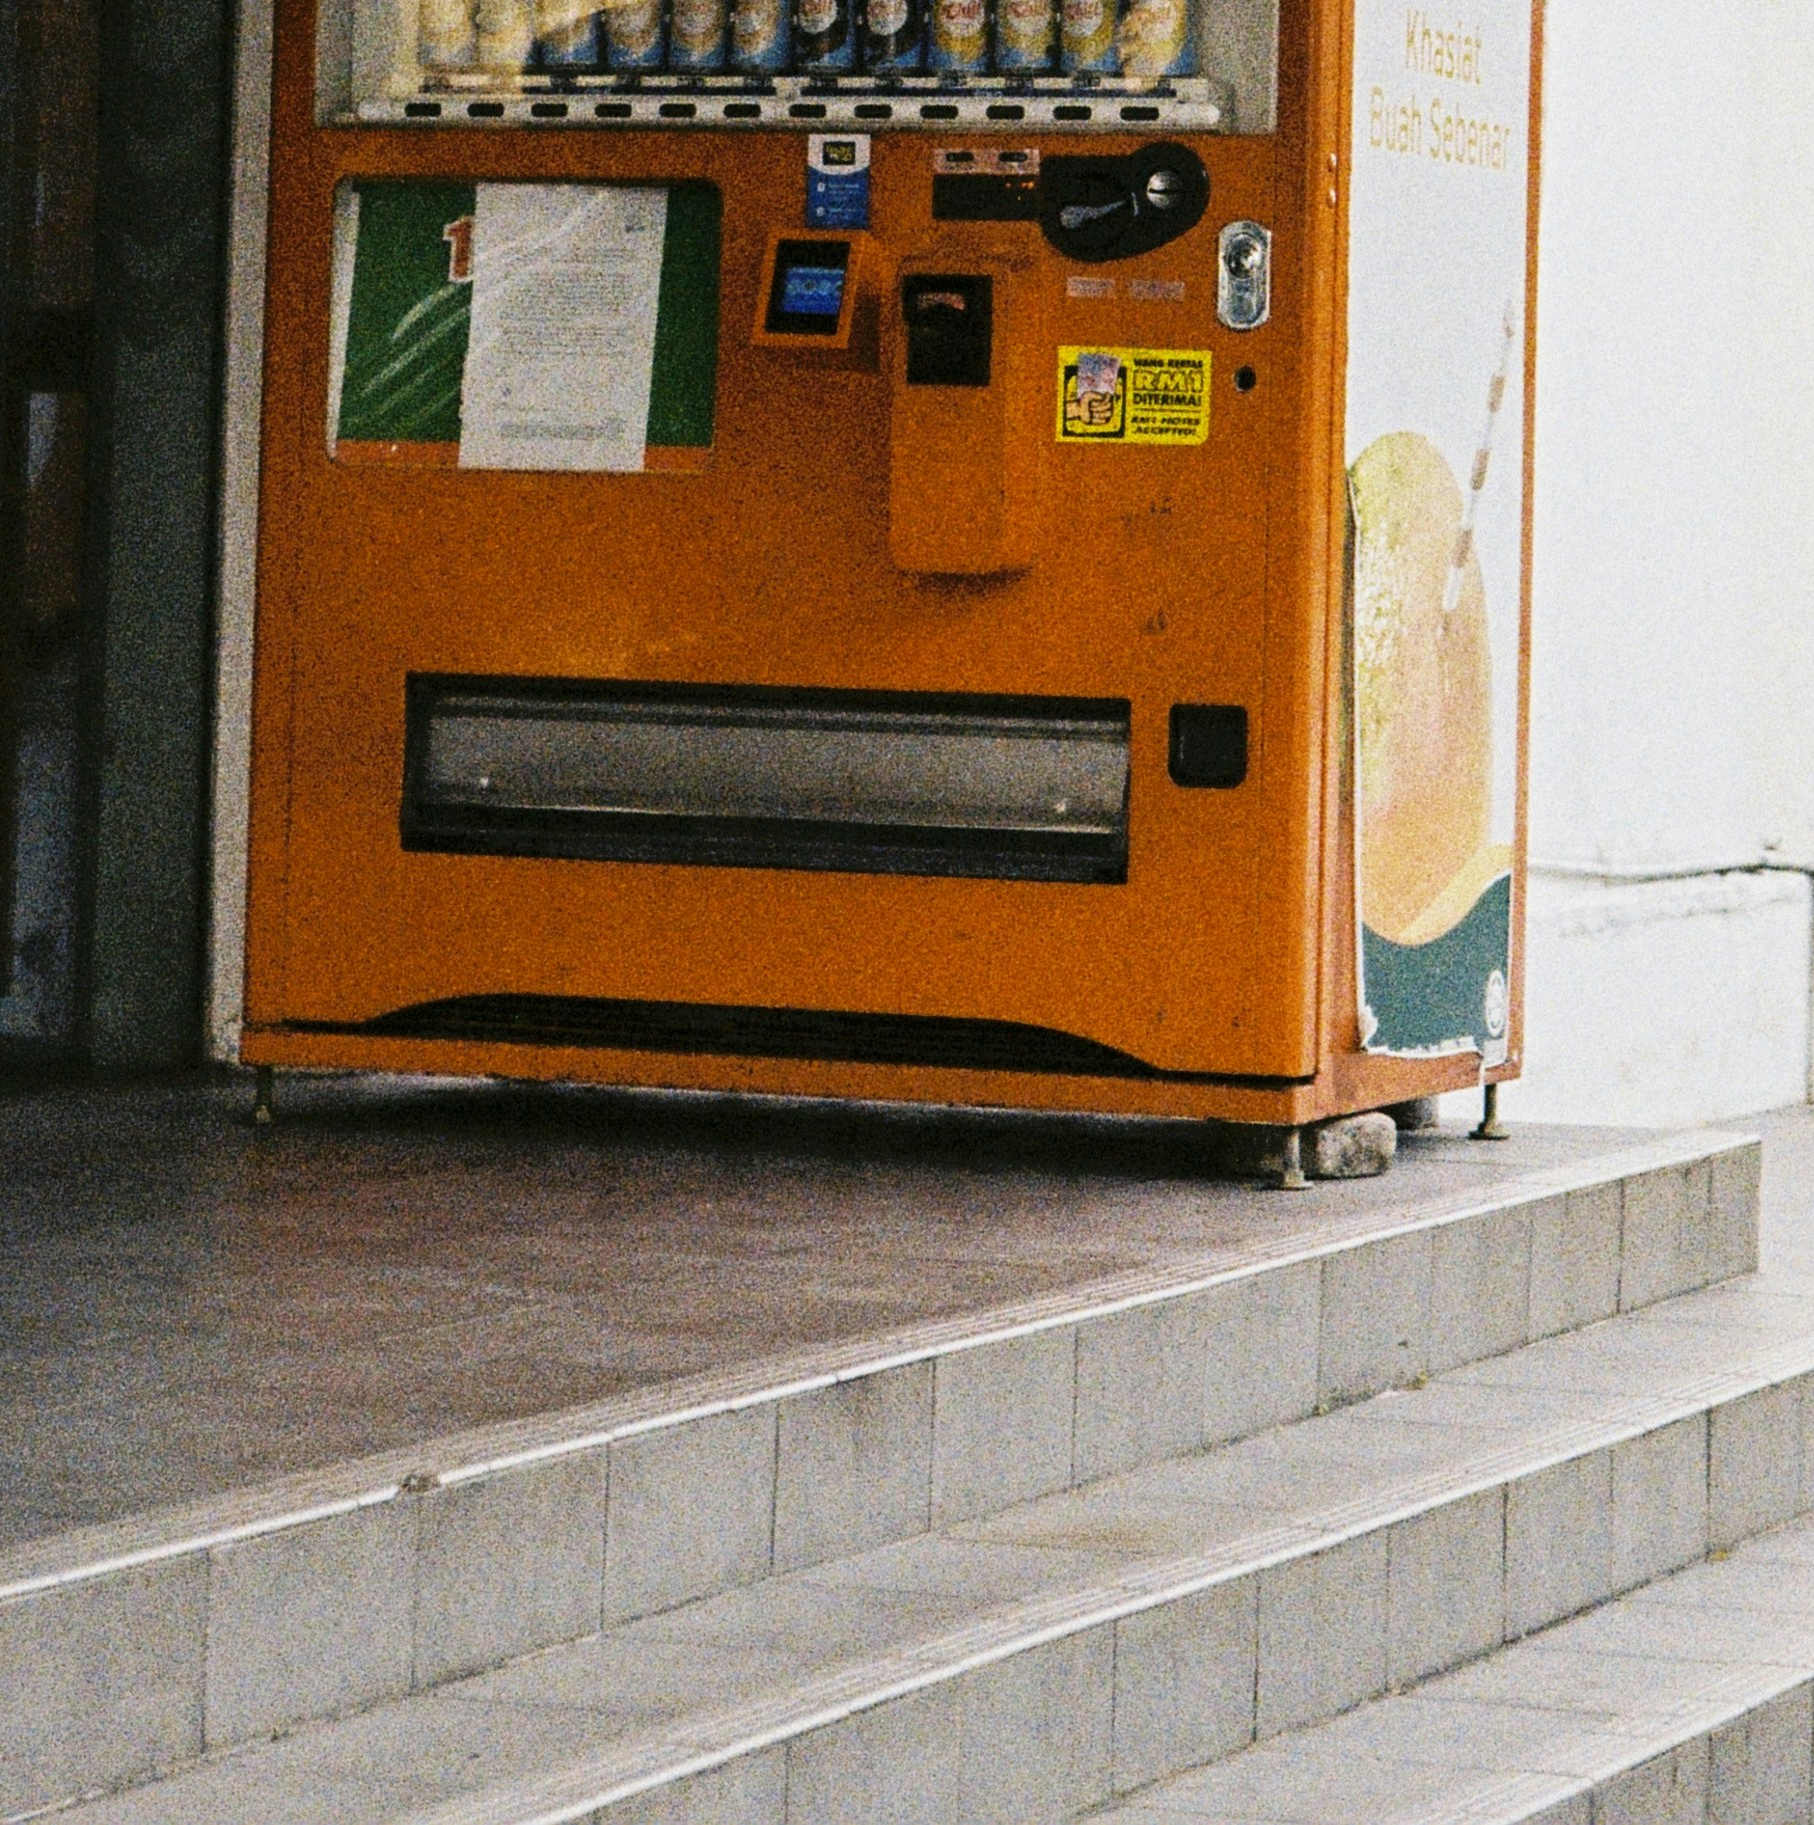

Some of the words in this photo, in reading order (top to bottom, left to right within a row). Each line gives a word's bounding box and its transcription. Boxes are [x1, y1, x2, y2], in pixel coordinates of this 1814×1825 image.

[1405, 5, 1482, 86] Khasiat
[1369, 83, 1422, 155] Buah
[1429, 96, 1512, 173] Sebenar
[1132, 368, 1204, 393] RM1
